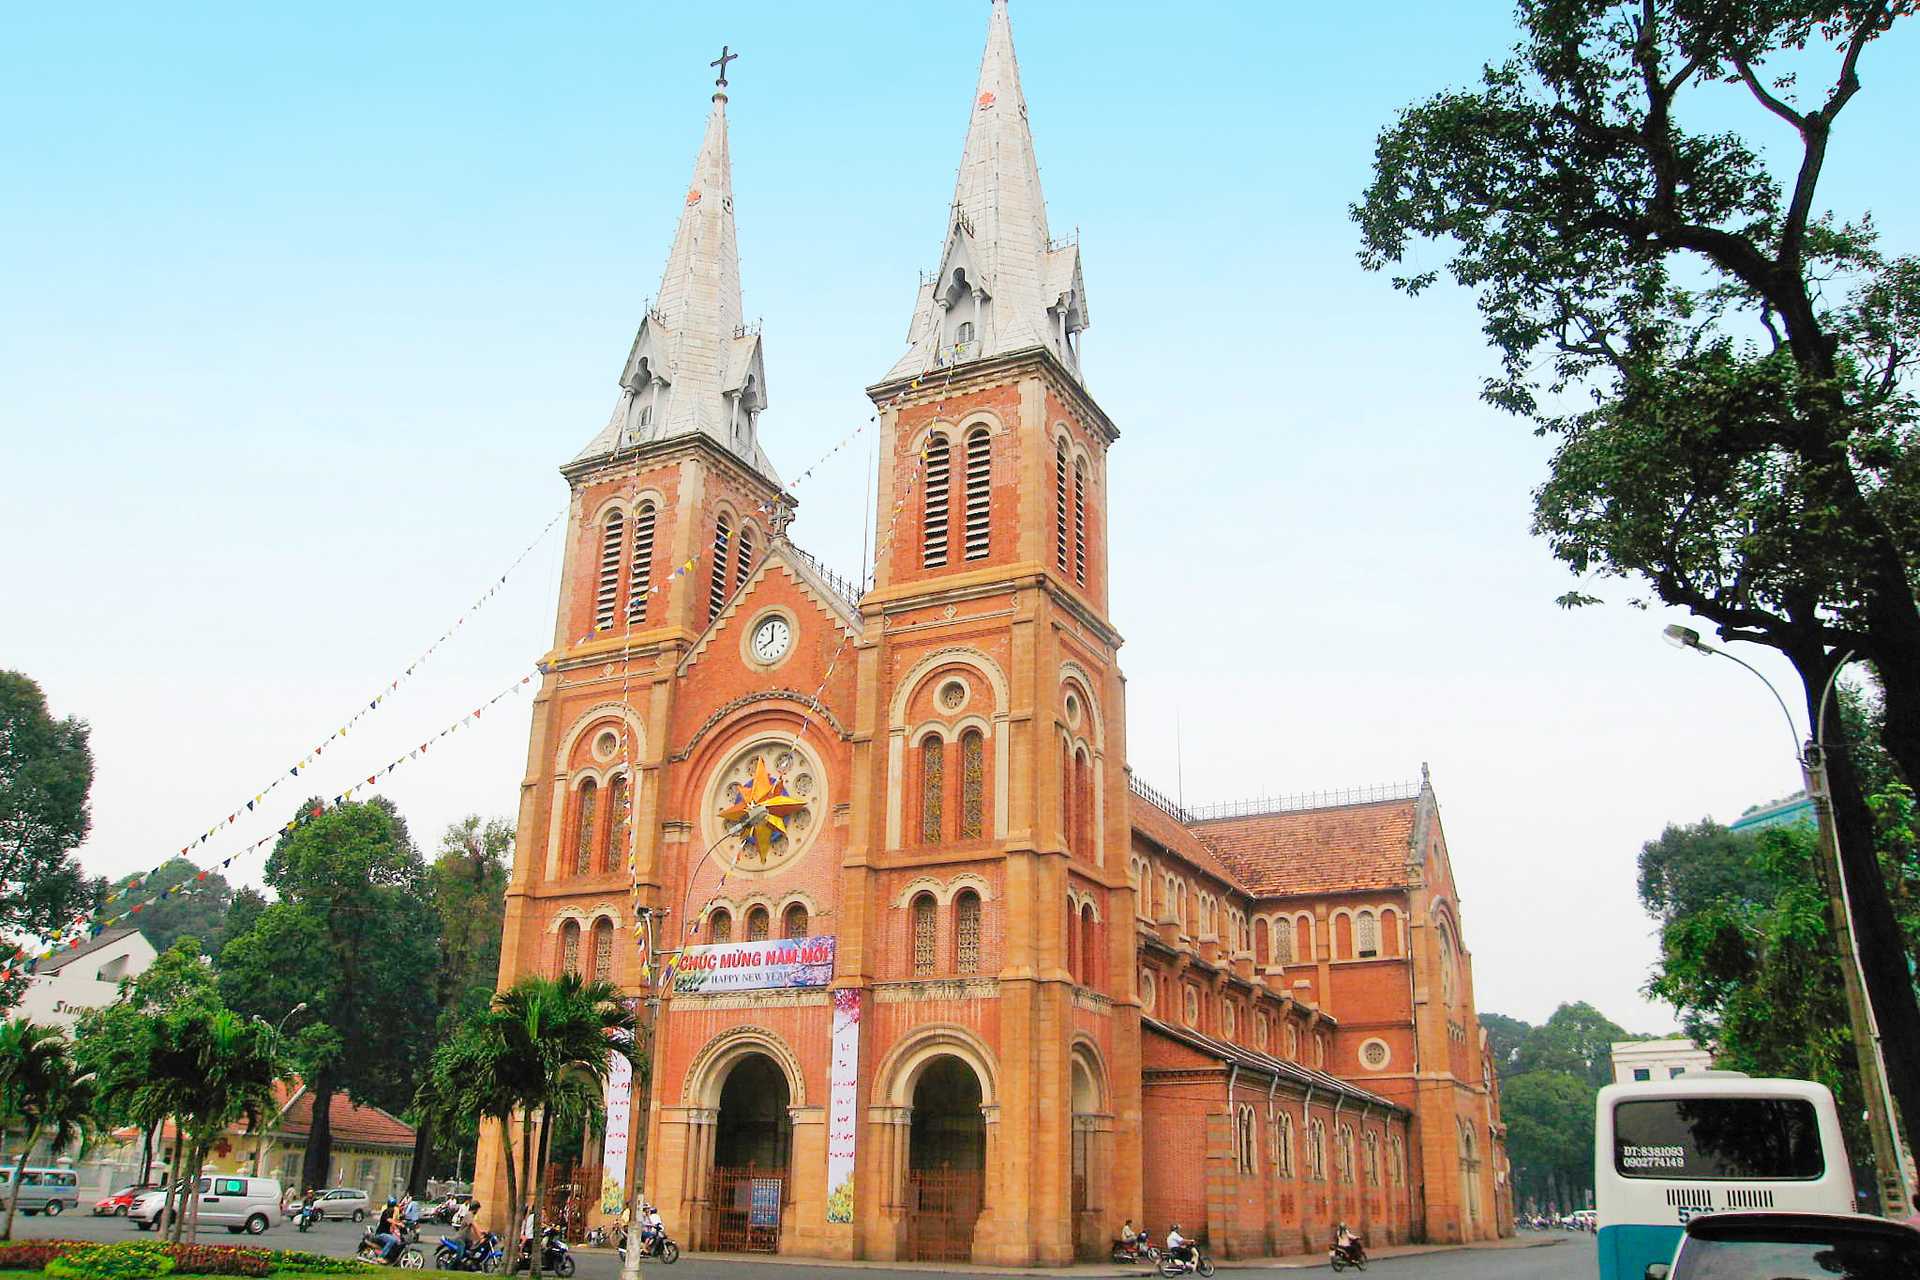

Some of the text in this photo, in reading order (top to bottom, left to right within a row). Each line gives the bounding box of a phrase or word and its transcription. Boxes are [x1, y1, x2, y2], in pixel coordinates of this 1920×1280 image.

[679, 951, 717, 972] CHÚC
[711, 974, 738, 984] HAPPY
[742, 972, 761, 982] NEW
